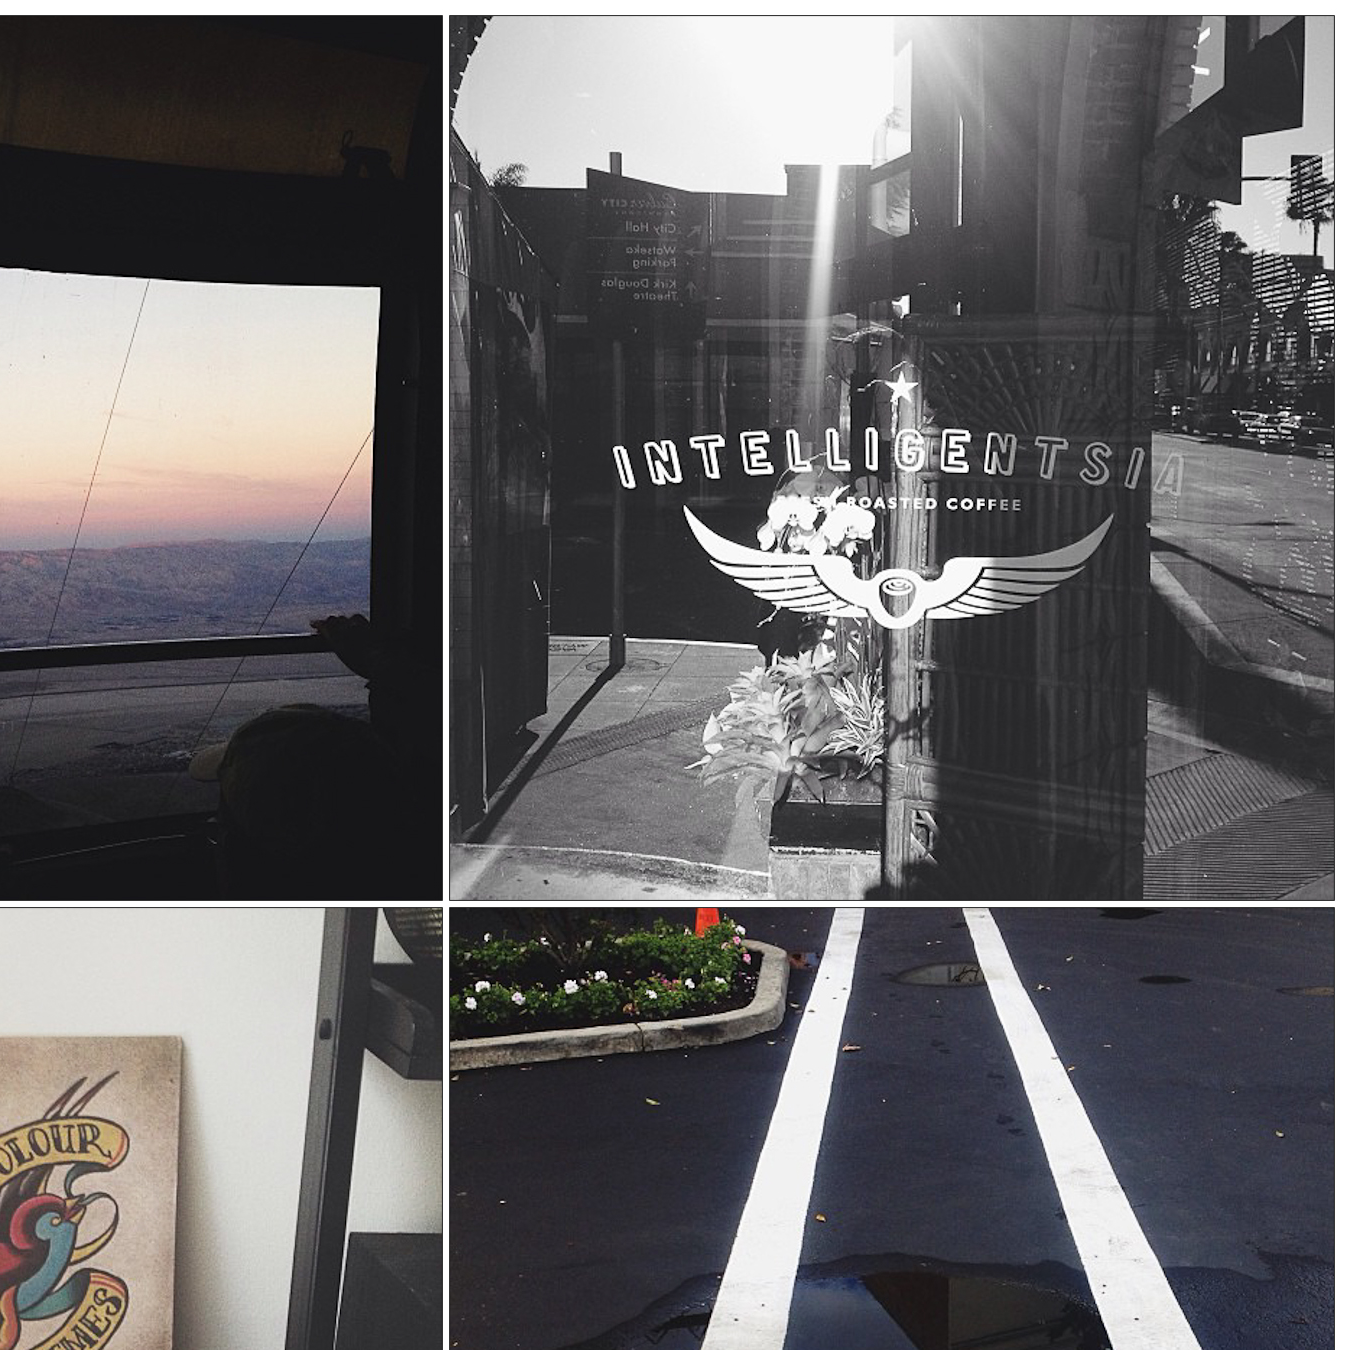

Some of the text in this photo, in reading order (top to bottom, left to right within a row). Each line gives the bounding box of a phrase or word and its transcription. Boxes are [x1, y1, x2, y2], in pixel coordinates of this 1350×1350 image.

[612, 426, 1184, 496] INTELLIGENTSIA
[847, 496, 938, 510] ROASTED
[946, 498, 1022, 511] COFFEE
